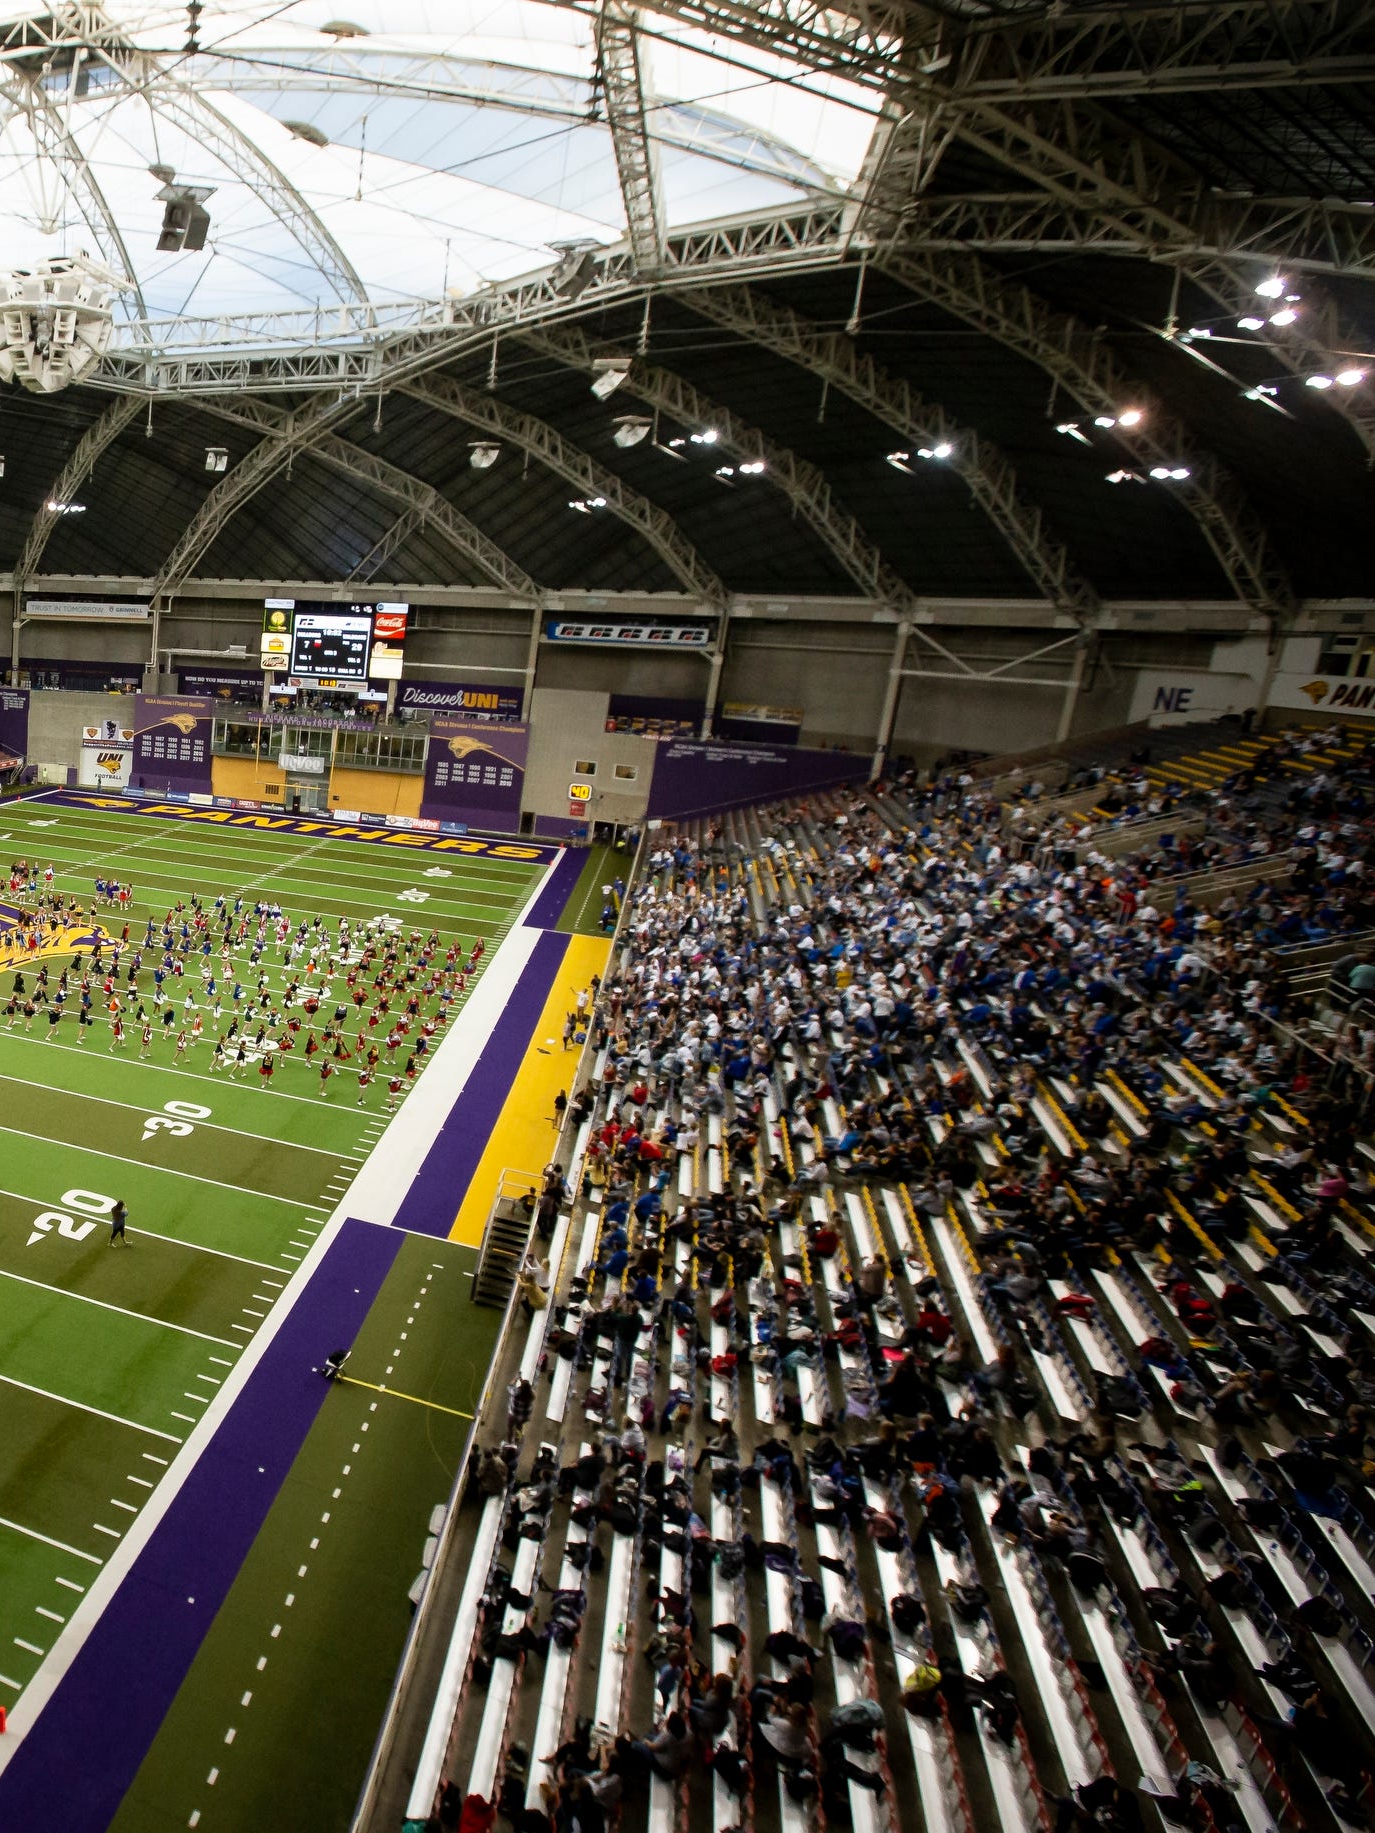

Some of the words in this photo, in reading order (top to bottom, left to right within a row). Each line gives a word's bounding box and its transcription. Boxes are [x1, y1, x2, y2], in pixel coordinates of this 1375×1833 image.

[31, 604, 52, 612] TRUST
[63, 605, 105, 614] TOMORROW
[304, 640, 310, 648] 7
[403, 687, 465, 706] Discover
[463, 692, 499, 710] UNI
[1153, 686, 1194, 713] NE
[97, 752, 124, 763] UNI
[572, 786, 589, 799] 40
[137, 805, 542, 860] PANTHERS
[143, 1100, 213, 1137] 30
[33, 1188, 118, 1242] 20
